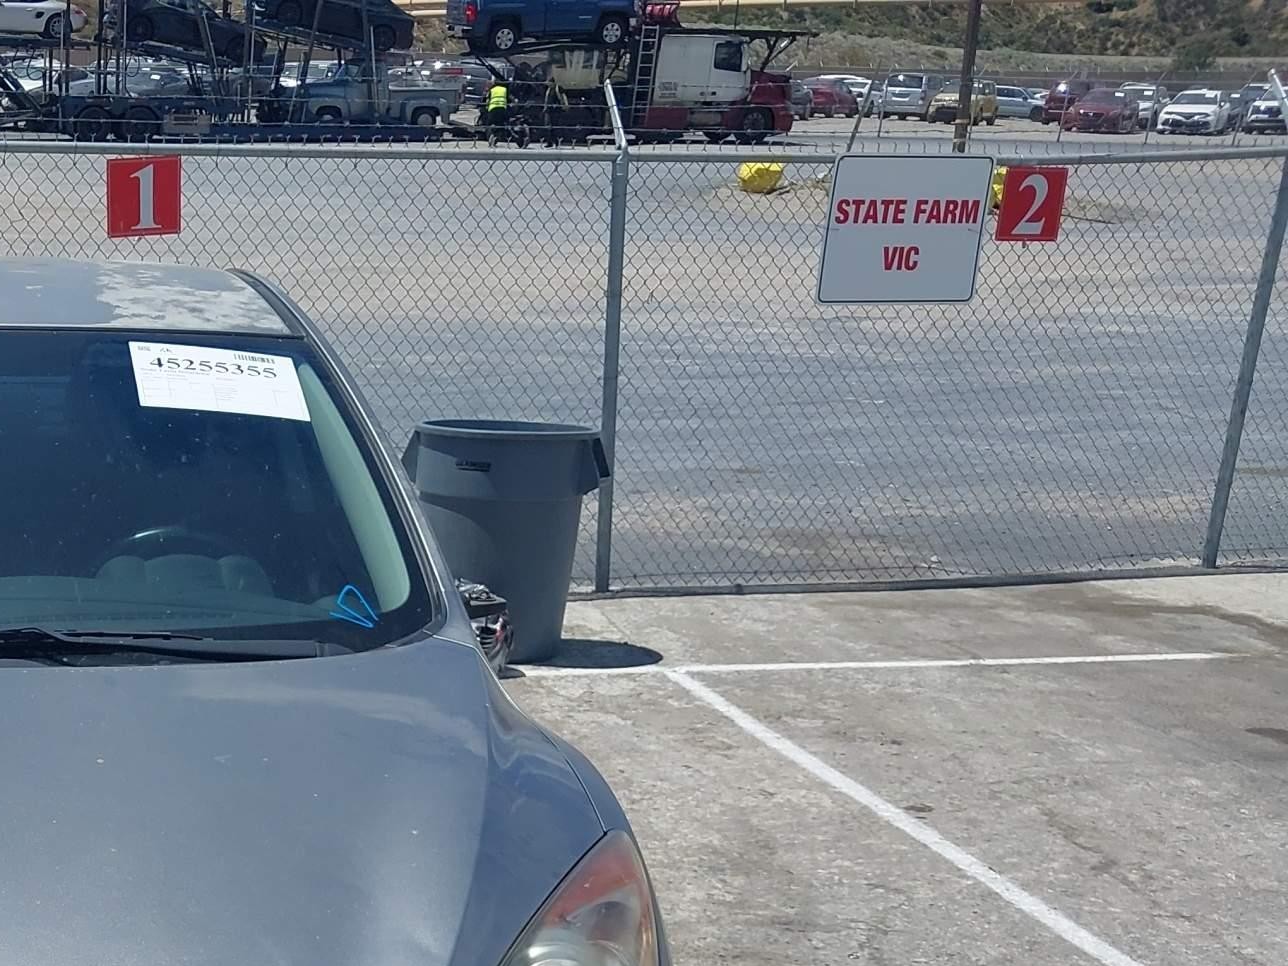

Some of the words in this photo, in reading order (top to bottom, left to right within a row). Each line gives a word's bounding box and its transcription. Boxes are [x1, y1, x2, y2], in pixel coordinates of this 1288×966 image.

[129, 164, 162, 229] 1
[1011, 174, 1049, 235] 2
[835, 199, 907, 225] STATE
[913, 199, 981, 225] FARM
[883, 246, 920, 271] VIC
[150, 357, 277, 379] 45255355
